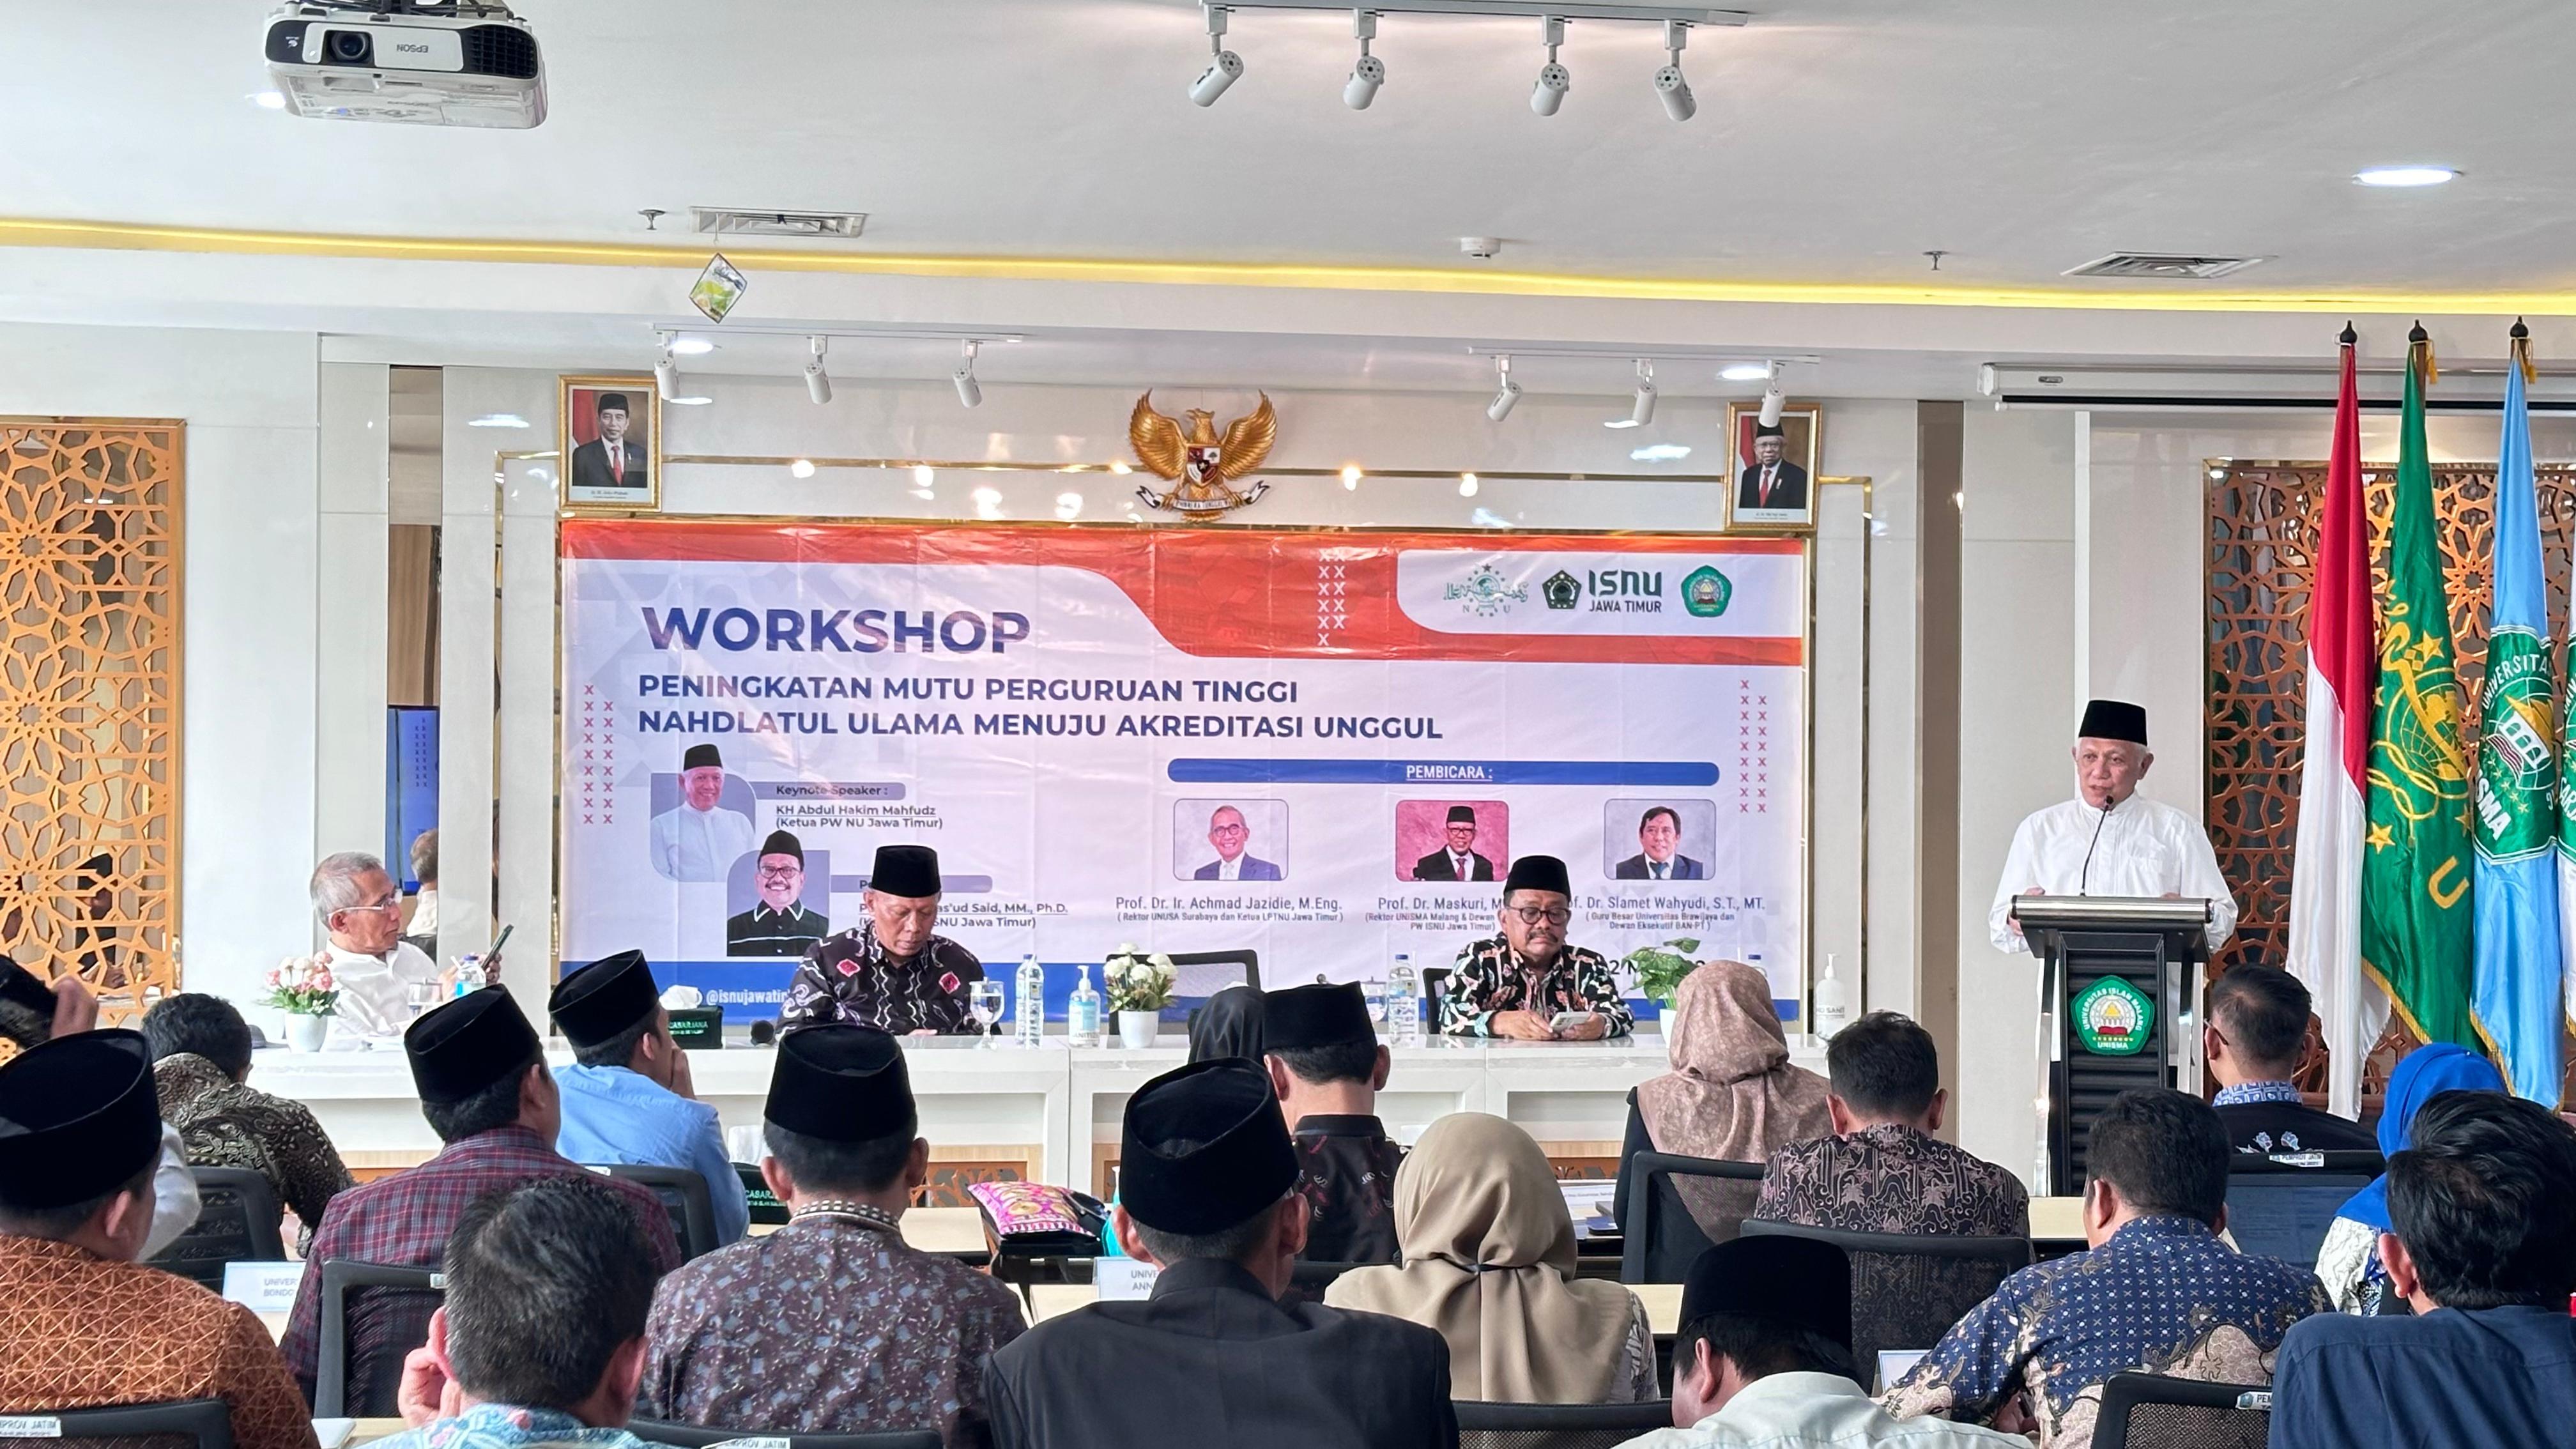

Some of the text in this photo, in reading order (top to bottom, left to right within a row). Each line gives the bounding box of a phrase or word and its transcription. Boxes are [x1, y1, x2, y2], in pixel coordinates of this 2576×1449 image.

[396, 44, 429, 53] EPSON
[1589, 601, 1662, 613] JAWA TIMUR
[641, 606, 1031, 654] WORKSHOP
[2482, 654, 2551, 710] UNIVERSITA
[640, 675, 1298, 703] PENINGKATAN MUTU PERGURUAN TINGGI
[640, 710, 1443, 739] NAHDLATUL ULAMA MENUJU AKREDITASI UNGGUL
[1406, 765, 1485, 779] PEMBICARA
[776, 785, 827, 797] Keynote
[831, 785, 882, 797] Speaker
[776, 805, 936, 815] KH Abdul Hakim Mahfudz
[2476, 772, 2511, 841] SMA
[776, 817, 943, 829] (Ketua PW NU Jawa Timur)
[938, 903, 968, 913] as'ud
[972, 903, 1001, 914] Said,
[1036, 903, 1068, 913] Ph.D.
[1116, 897, 1342, 912] Prof. Dr. Ir. Achmad Jazidie, M.Eng.
[1379, 897, 1408, 910] Prof.
[1413, 898, 1430, 910] Dr.
[1434, 897, 1487, 911] Maskuri,
[1587, 897, 1603, 908] Dr.
[1608, 896, 1650, 909] Slamet
[1654, 896, 1710, 912] Wahyudi,
[1713, 898, 1740, 911] S.T.,
[1744, 898, 1765, 910] MT.
[961, 917, 993, 926] Jawa
[997, 917, 1036, 928] Timur)
[1182, 913, 1218, 923] Surabaya
[1238, 913, 1260, 921] Ketua
[1315, 913, 1338, 921] Timur
[1365, 912, 1394, 922] (Rektor
[1430, 913, 1459, 923] Malang
[2082, 987, 2144, 1031] UNIVERSITAS ISLAM MALANG
[2097, 1041, 2129, 1050] UNISMA
